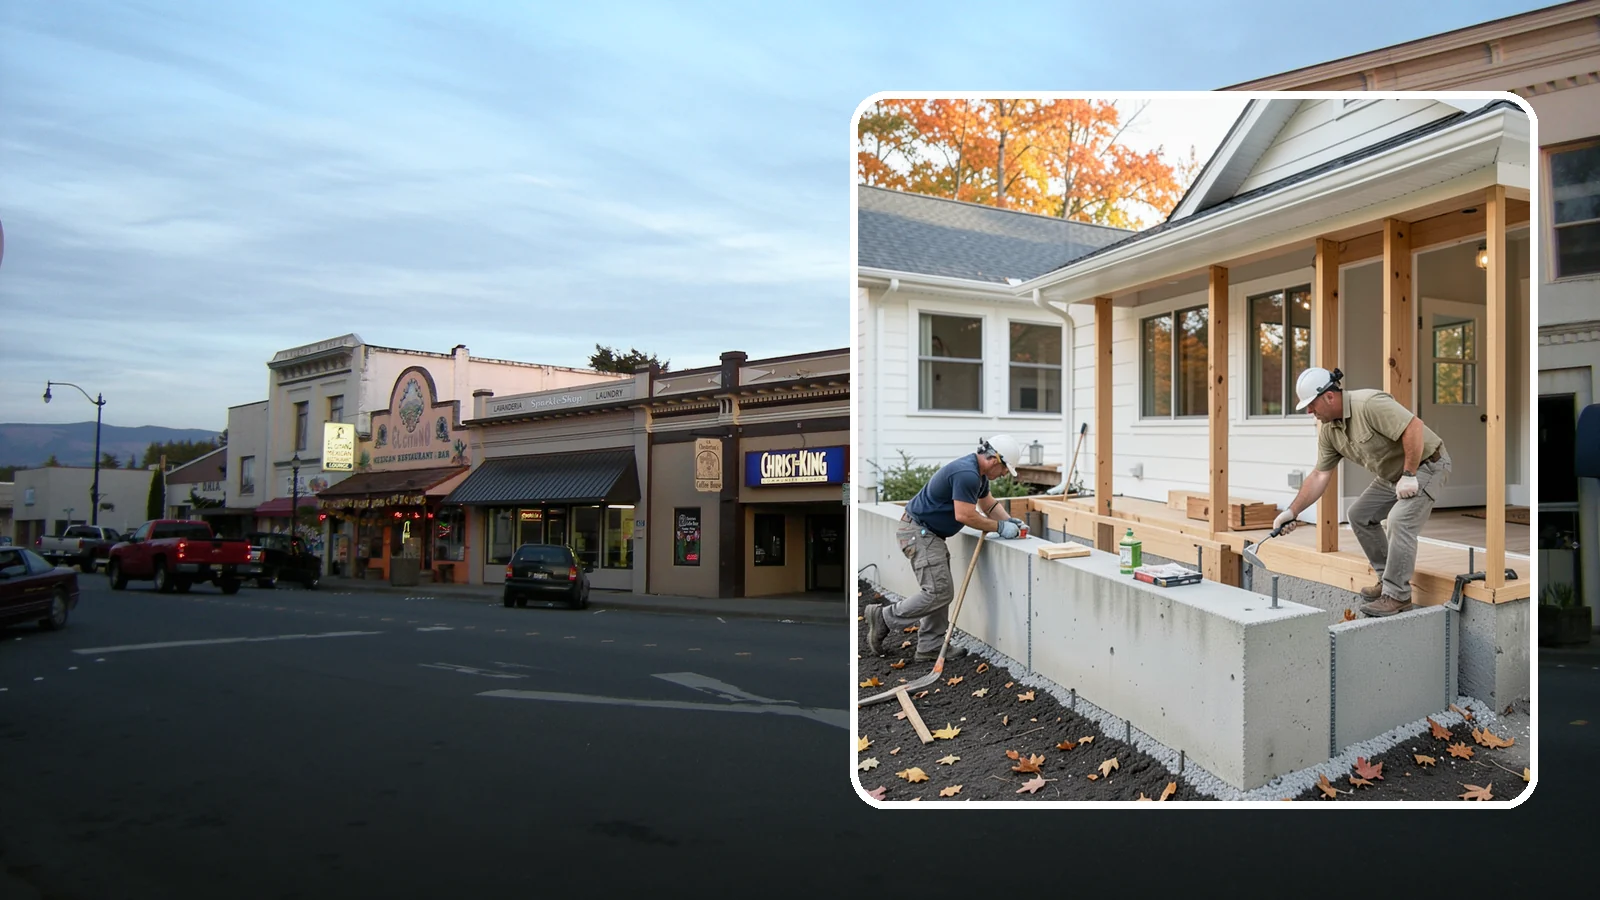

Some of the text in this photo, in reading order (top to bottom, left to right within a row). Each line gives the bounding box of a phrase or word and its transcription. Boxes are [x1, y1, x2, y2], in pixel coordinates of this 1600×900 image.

[596, 389, 623, 399] LAUNDRY
[493, 402, 522, 413] LAVANDERIA
[374, 454, 396, 464] MEXICAN
[397, 451, 433, 462] RESTAURANT
[438, 450, 450, 459] BAR
[760, 450, 827, 478] CHRIST KING
[696, 481, 721, 489] Coffee House
